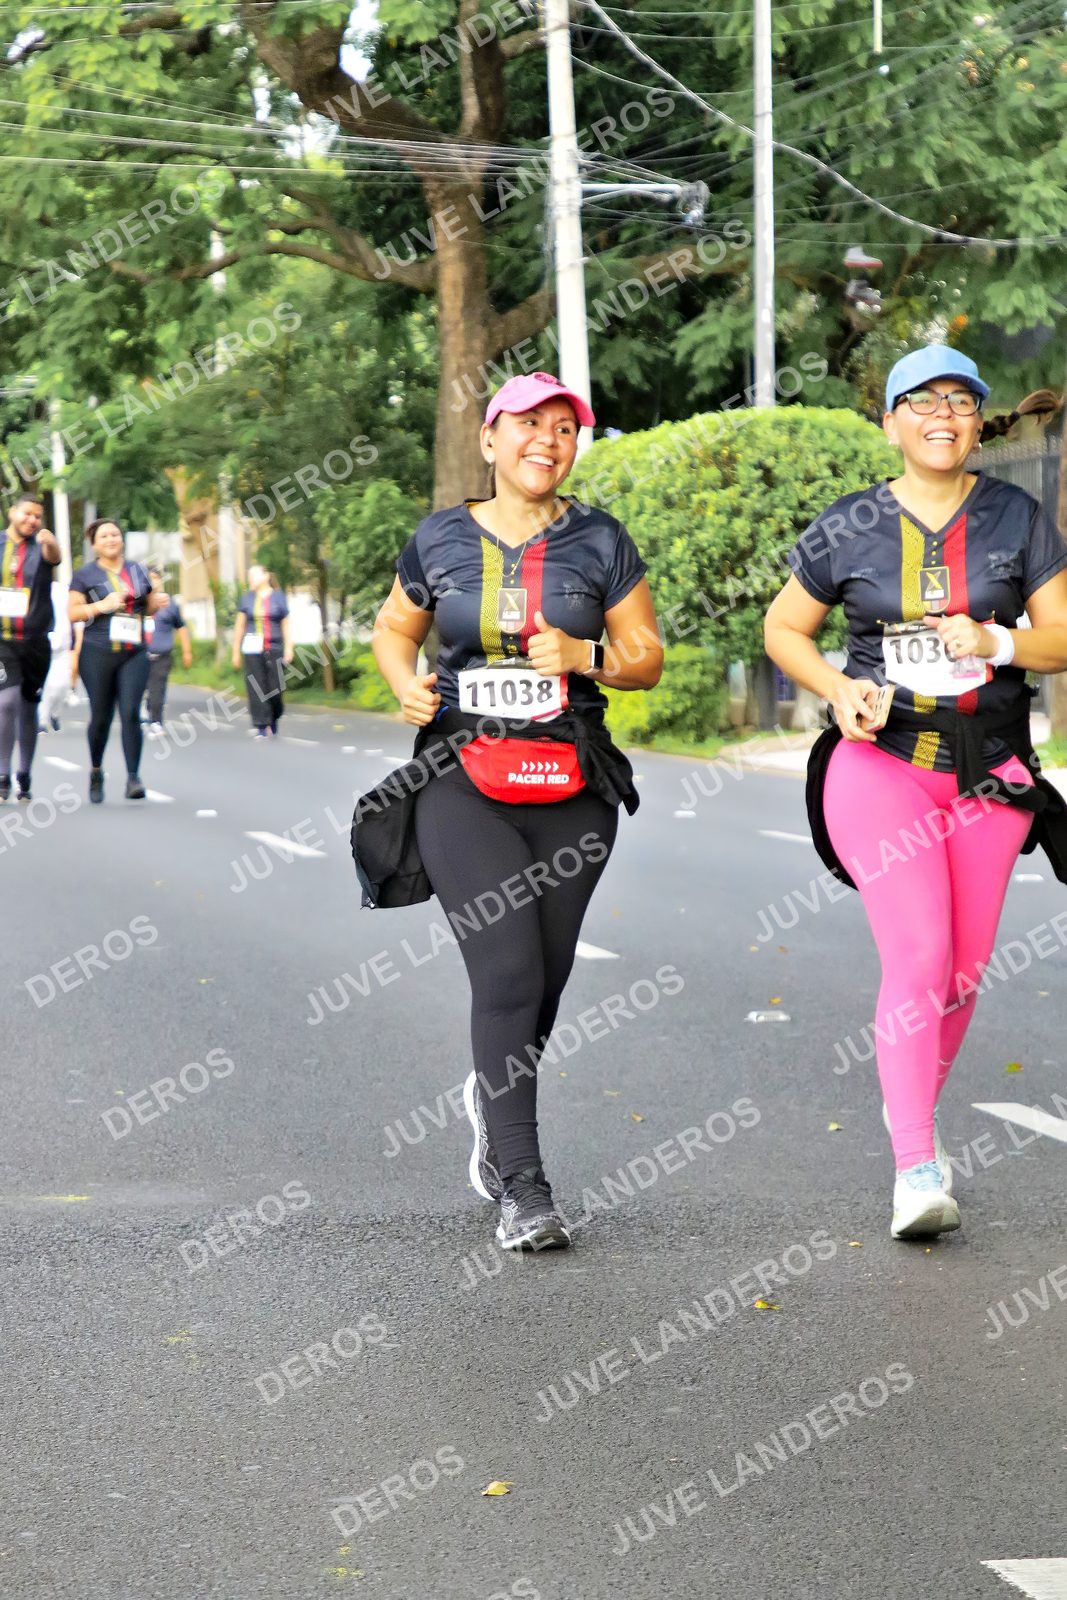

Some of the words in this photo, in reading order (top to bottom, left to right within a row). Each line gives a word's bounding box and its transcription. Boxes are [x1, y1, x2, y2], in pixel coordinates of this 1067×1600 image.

[467, 680, 552, 707] 11038
[508, 773, 545, 784] PACER
[547, 774, 569, 784] RED
